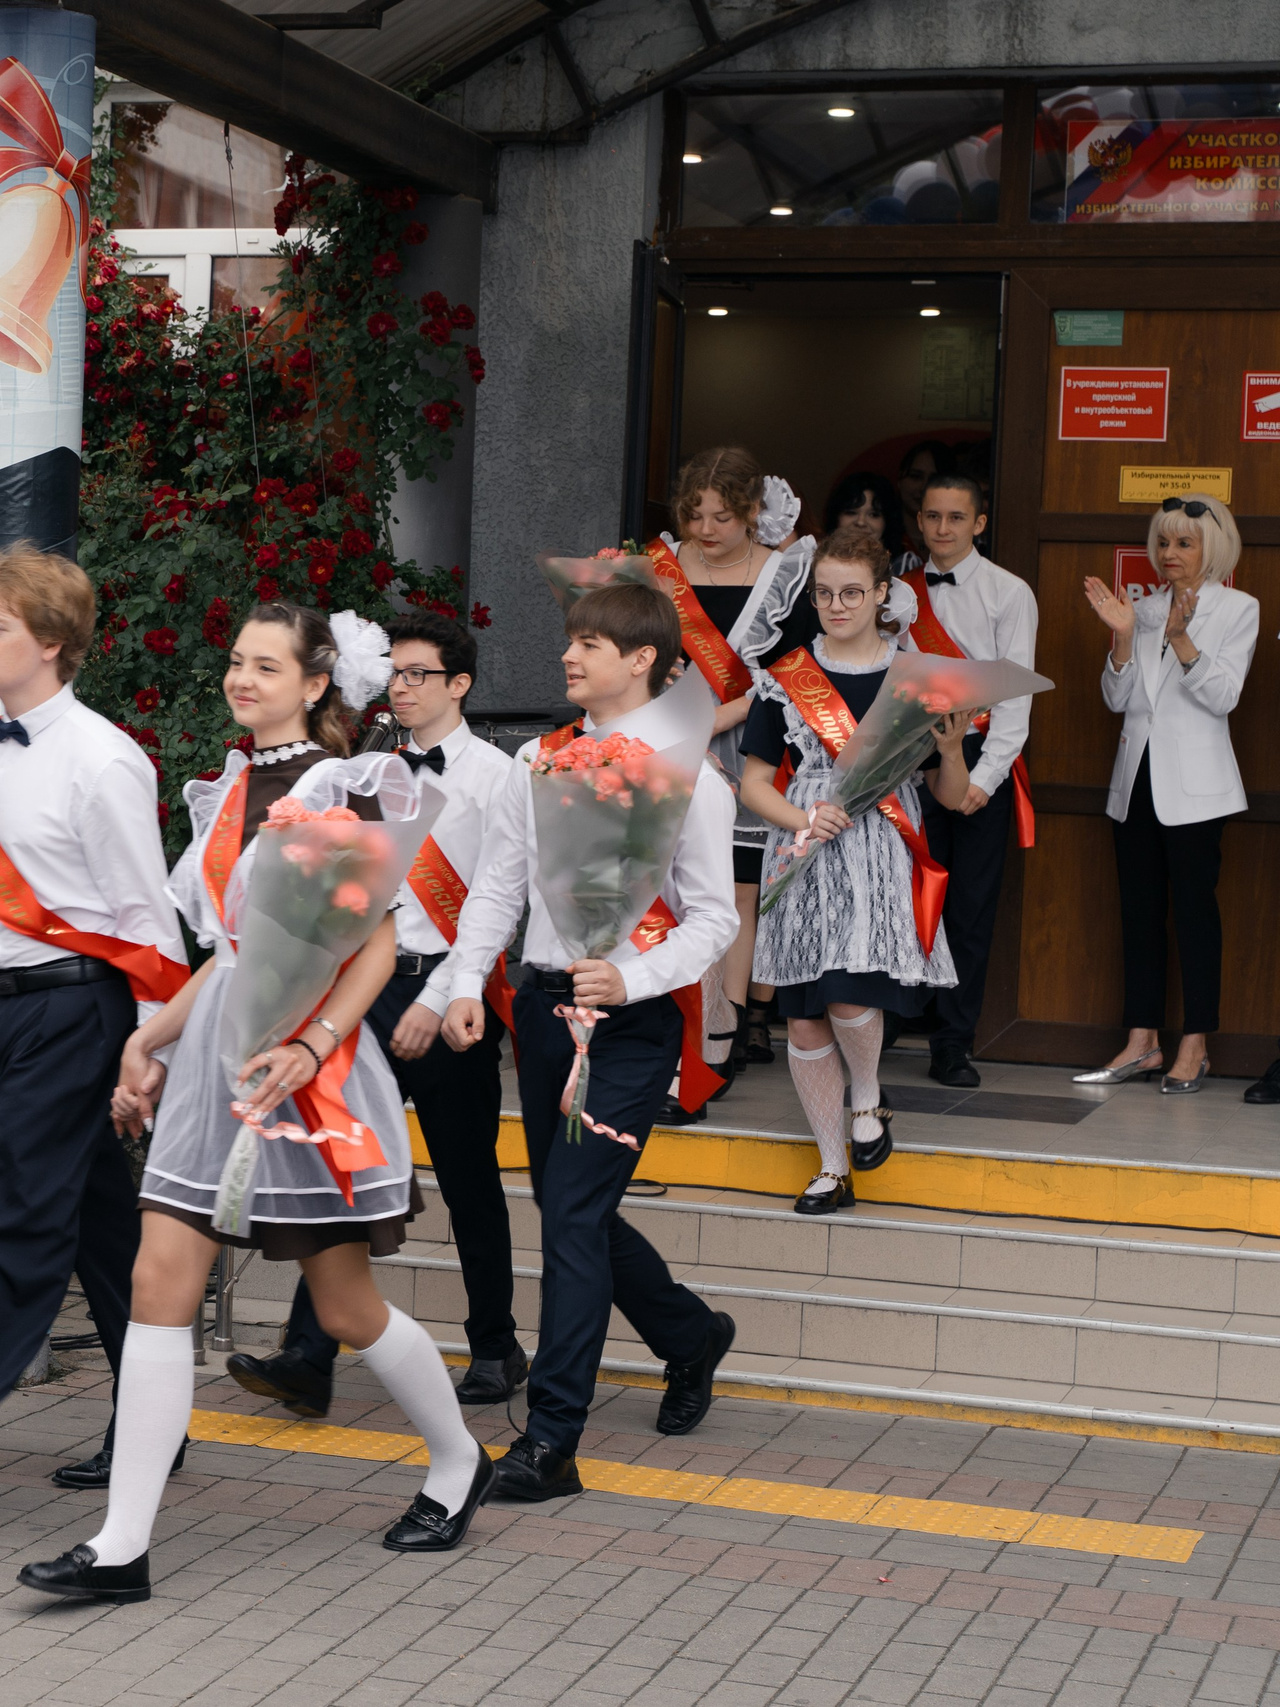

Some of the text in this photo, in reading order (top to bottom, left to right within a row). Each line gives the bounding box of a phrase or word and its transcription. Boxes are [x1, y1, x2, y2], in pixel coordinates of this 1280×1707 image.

[1187, 133, 1280, 148] УЧАСТКО
[1195, 177, 1280, 191] КОМИСС
[1075, 202, 1200, 214] ИЗБИРАТЕЛЬНОГО
[1205, 201, 1270, 213] УЧАСТКА
[1066, 379, 1164, 390] В учреждении установлен
[1092, 392, 1136, 403] пропускной
[1099, 420, 1127, 429] режим
[1131, 471, 1221, 481] Избирательный участок
[708, 632, 732, 661] Мария
[793, 669, 847, 752] Выпус
